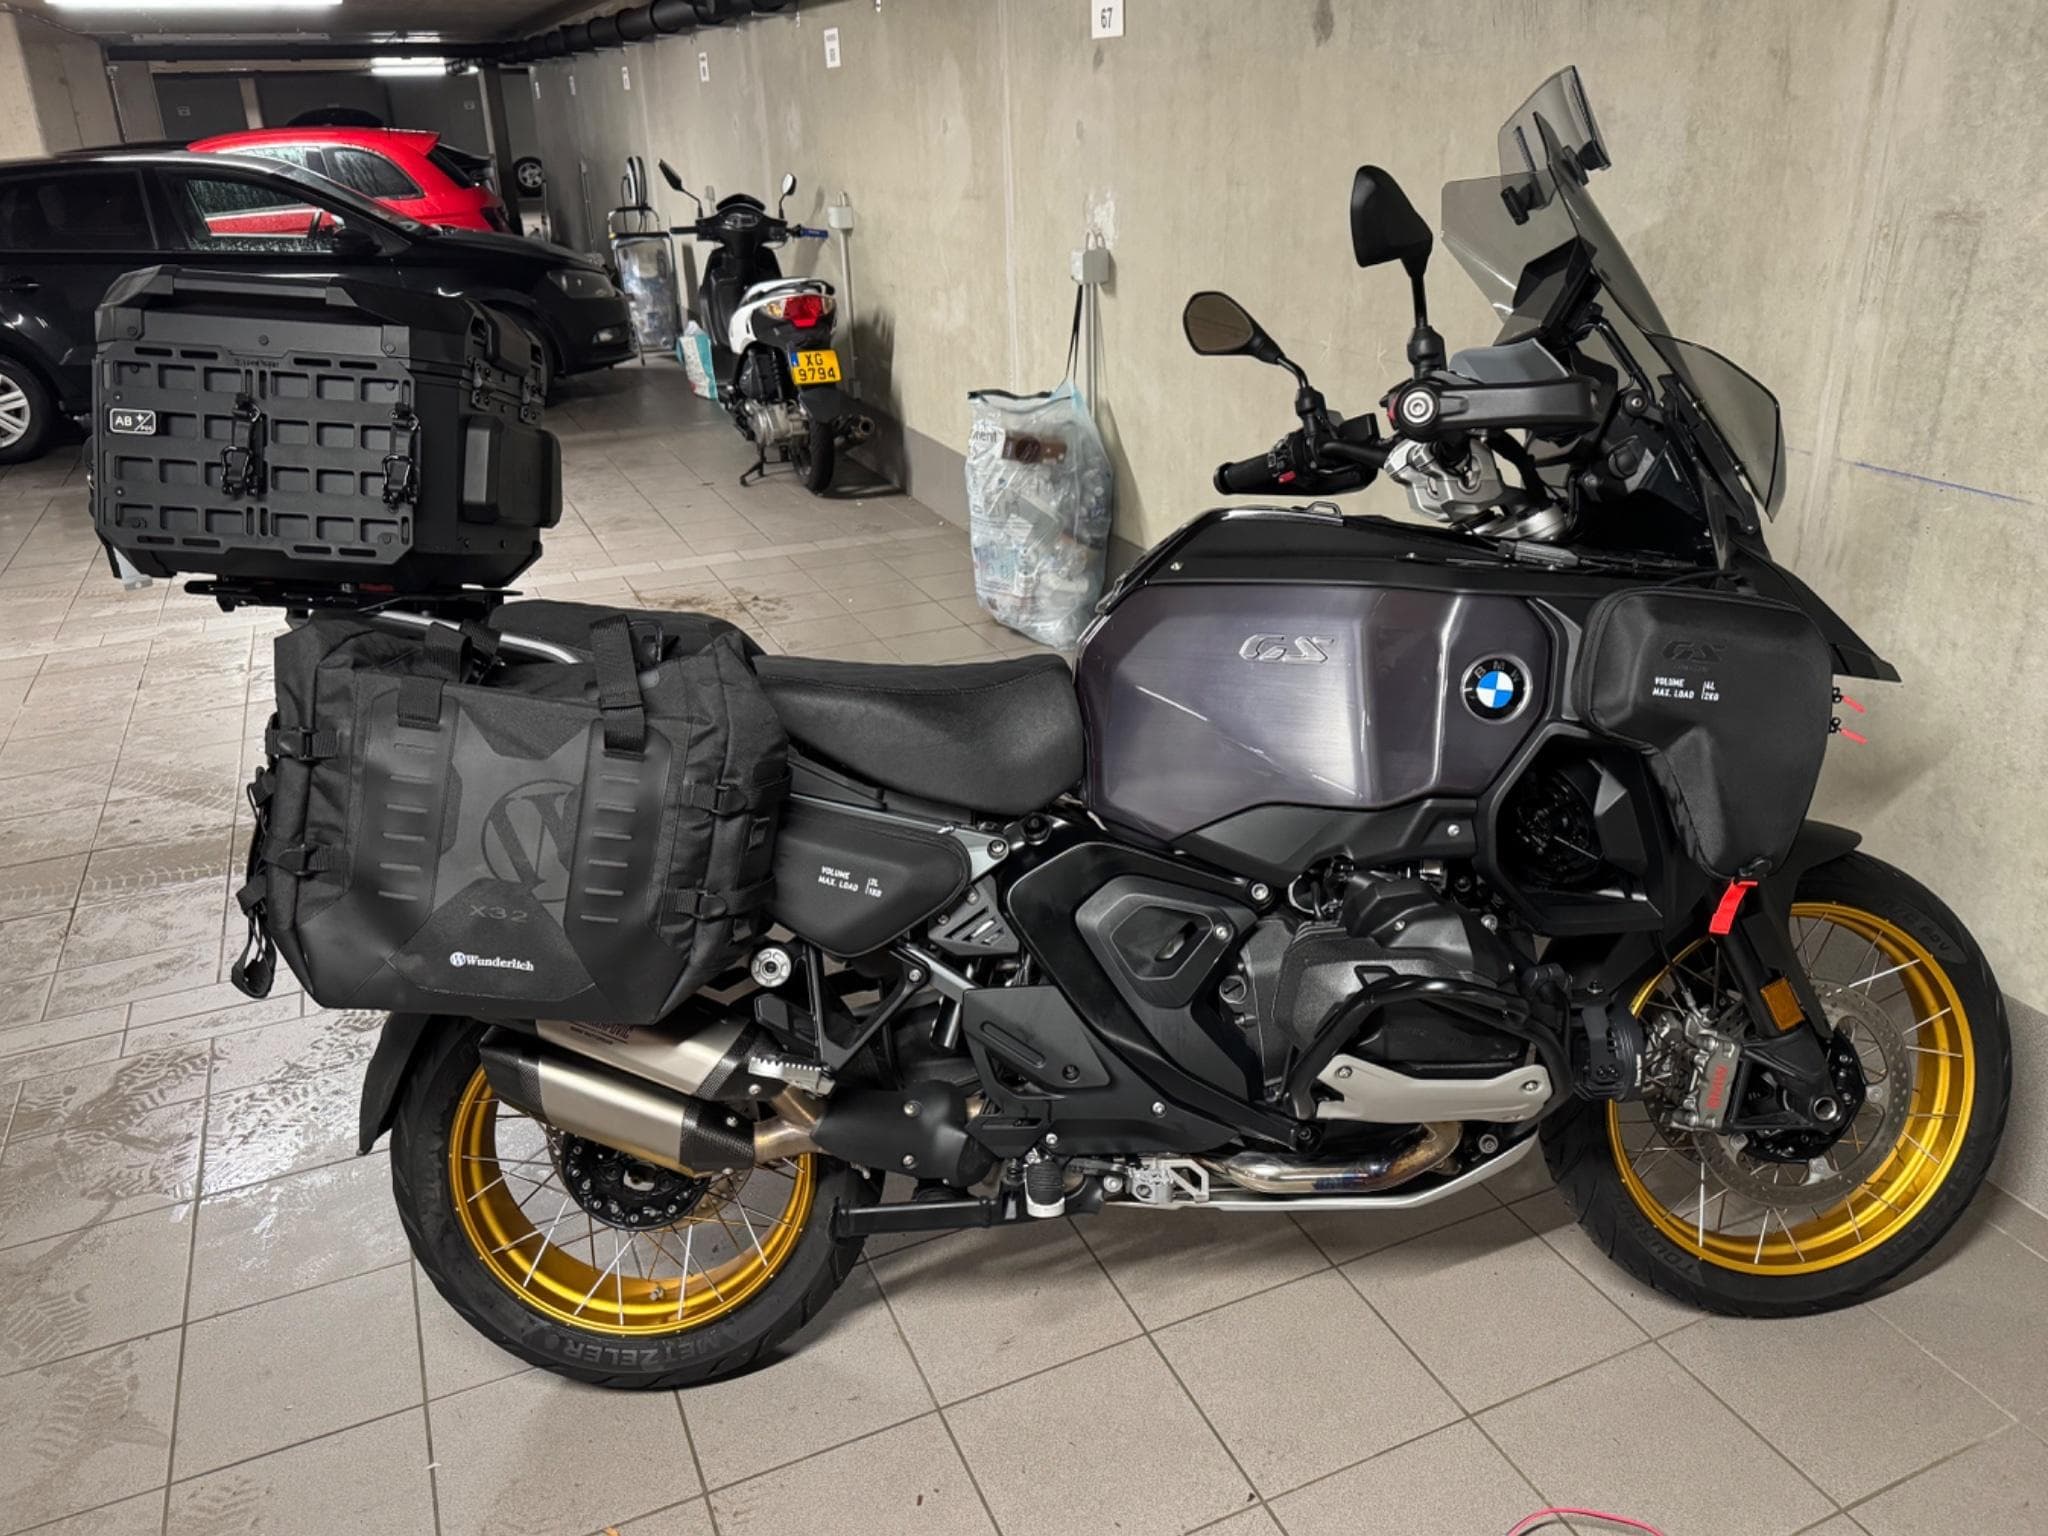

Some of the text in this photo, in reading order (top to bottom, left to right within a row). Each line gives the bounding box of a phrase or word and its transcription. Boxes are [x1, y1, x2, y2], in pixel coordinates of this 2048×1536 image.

[1100, 7, 1113, 29] 67
[805, 353, 824, 366] XG
[798, 367, 836, 381] 9794
[1239, 632, 1335, 665] GS
[1474, 660, 1521, 682] BMW
[1673, 688, 1695, 699] LOAD
[838, 880, 859, 892] LOAD
[465, 954, 534, 971] Wunderlich
[563, 1331, 724, 1371] METZELER
